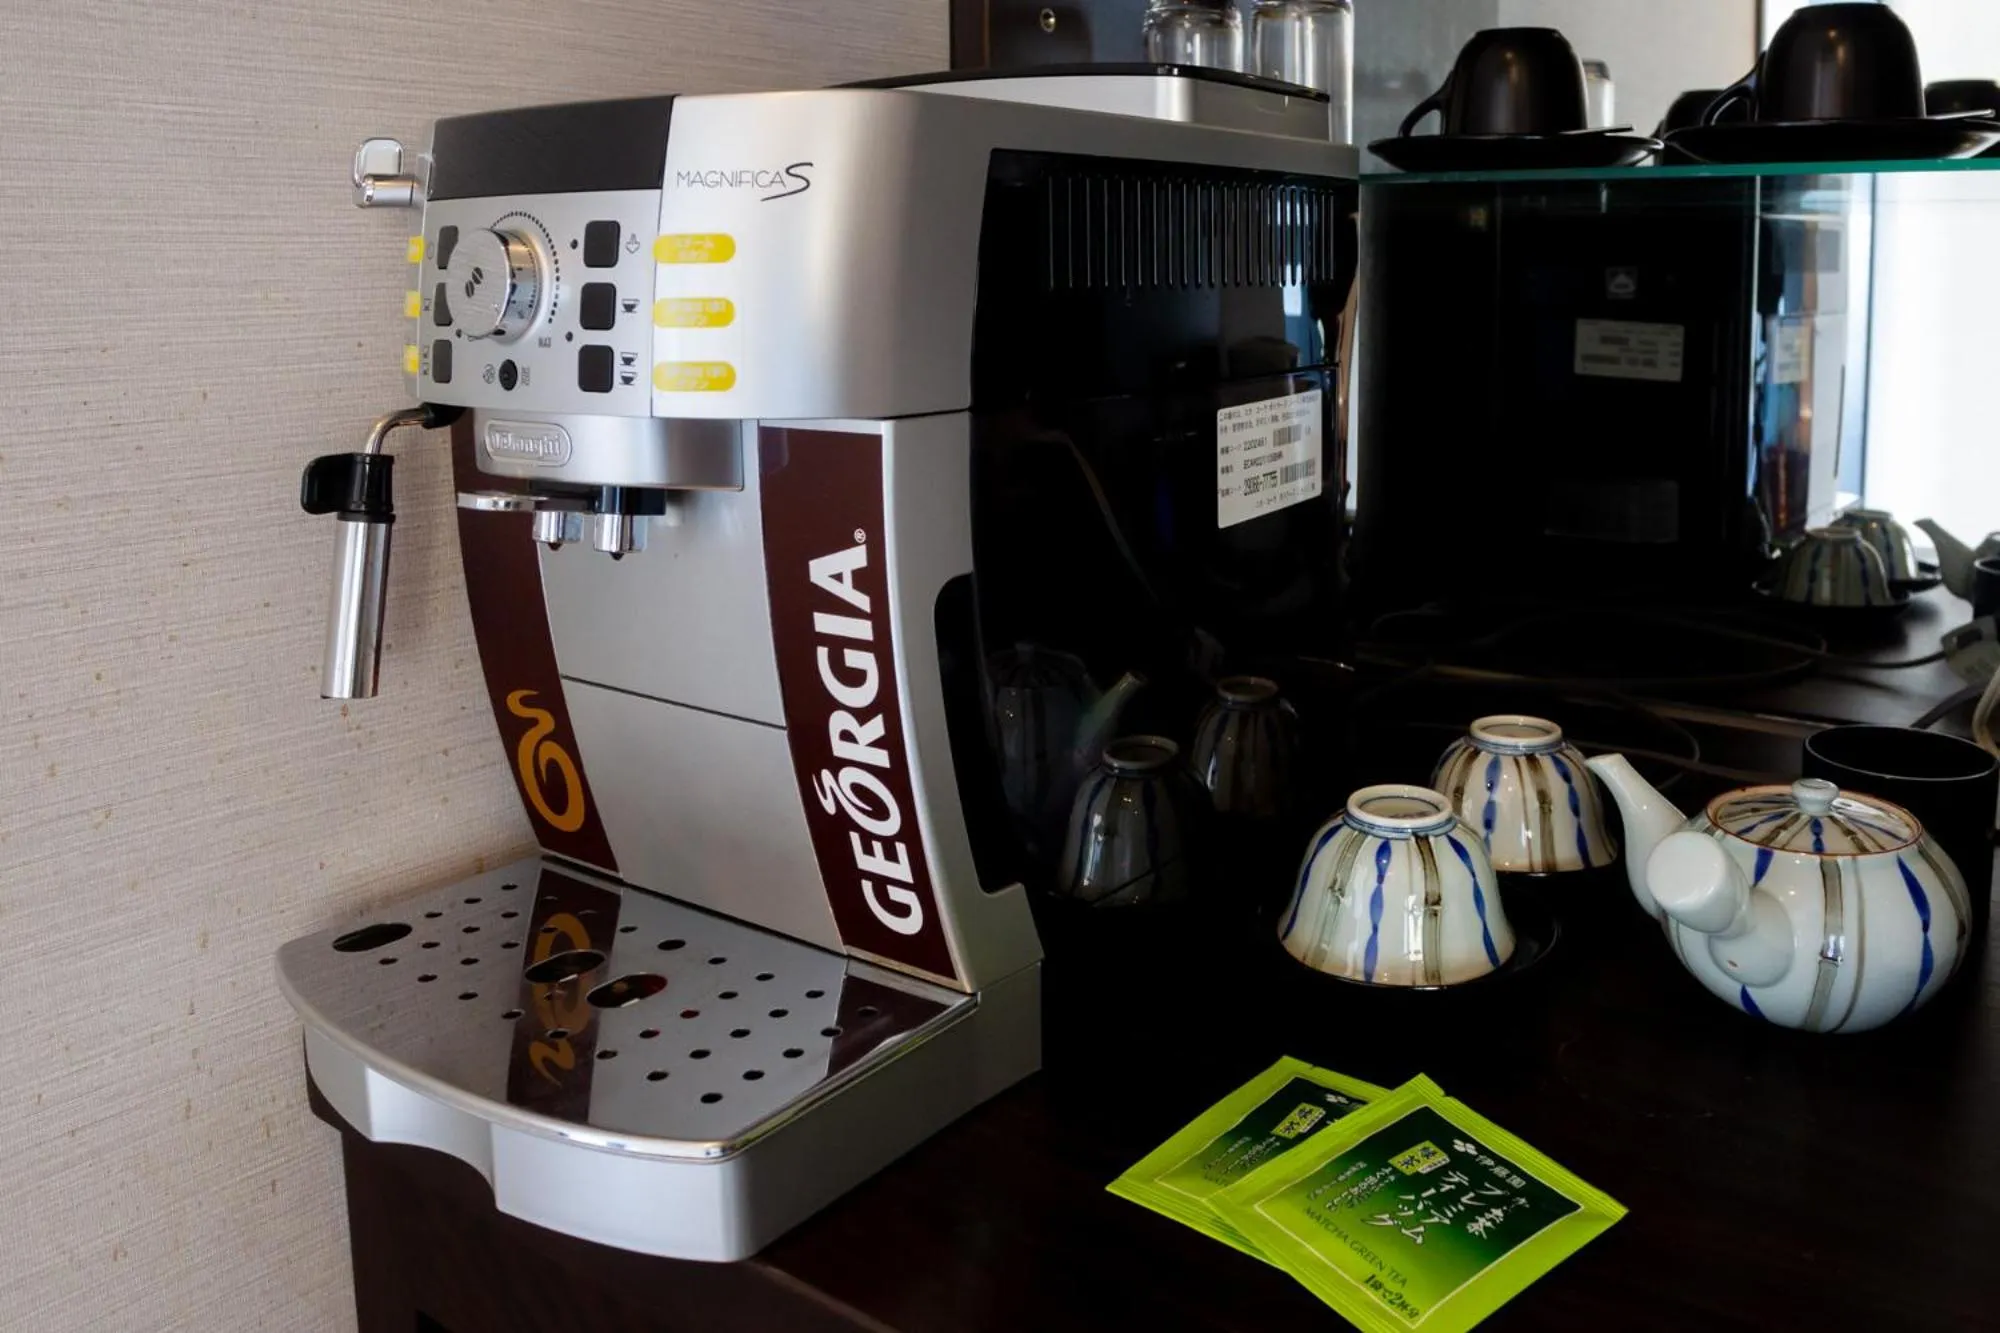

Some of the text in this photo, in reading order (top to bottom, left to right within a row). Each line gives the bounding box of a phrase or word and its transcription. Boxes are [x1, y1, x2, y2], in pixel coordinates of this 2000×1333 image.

[808, 543, 925, 937] GEORGIA
[1304, 1206, 1408, 1289] MATCHA GREEN TEA
